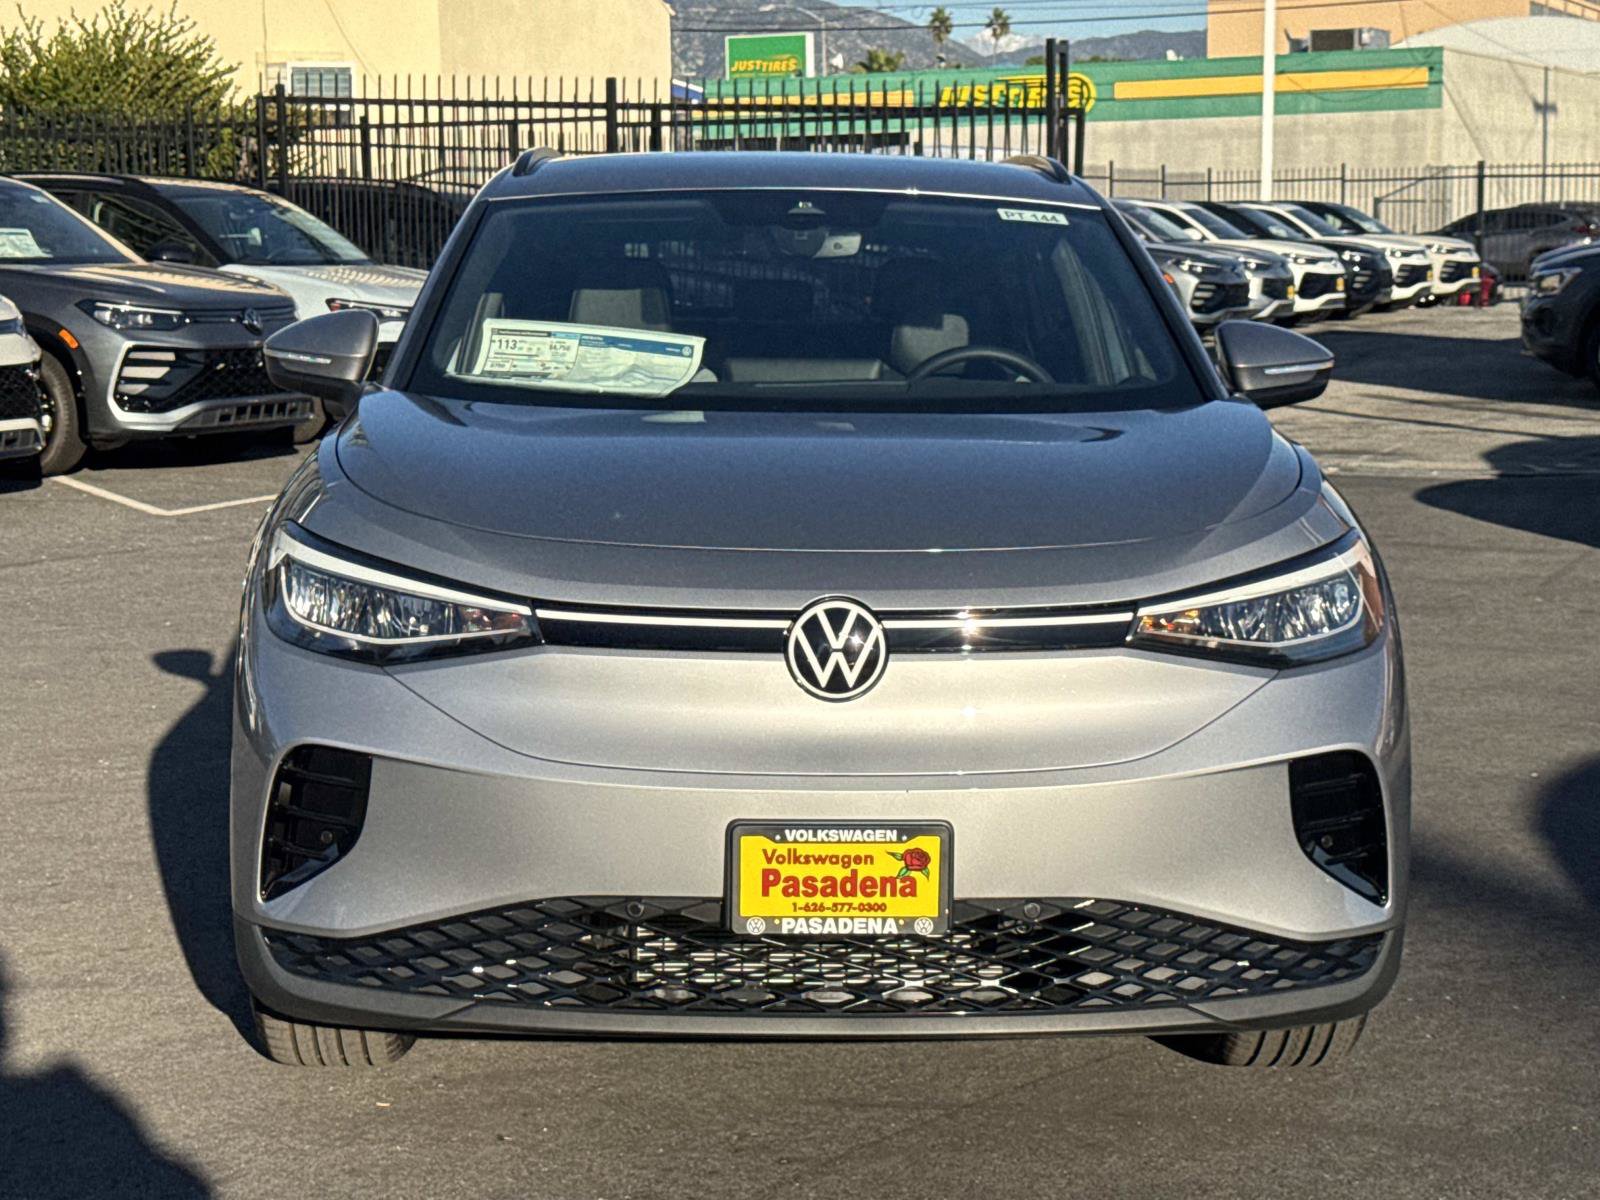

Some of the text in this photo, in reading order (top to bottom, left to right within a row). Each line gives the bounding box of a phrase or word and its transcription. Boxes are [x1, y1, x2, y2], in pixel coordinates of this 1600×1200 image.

[1003, 210, 1024, 220] PT
[498, 338, 518, 350] 113
[784, 829, 897, 842] VOLKSWAGEN
[762, 848, 875, 869] Volkswagen
[761, 868, 918, 898] Pasadena
[792, 902, 888, 913] 1-626-577-0300
[781, 918, 899, 934] PASADENA
